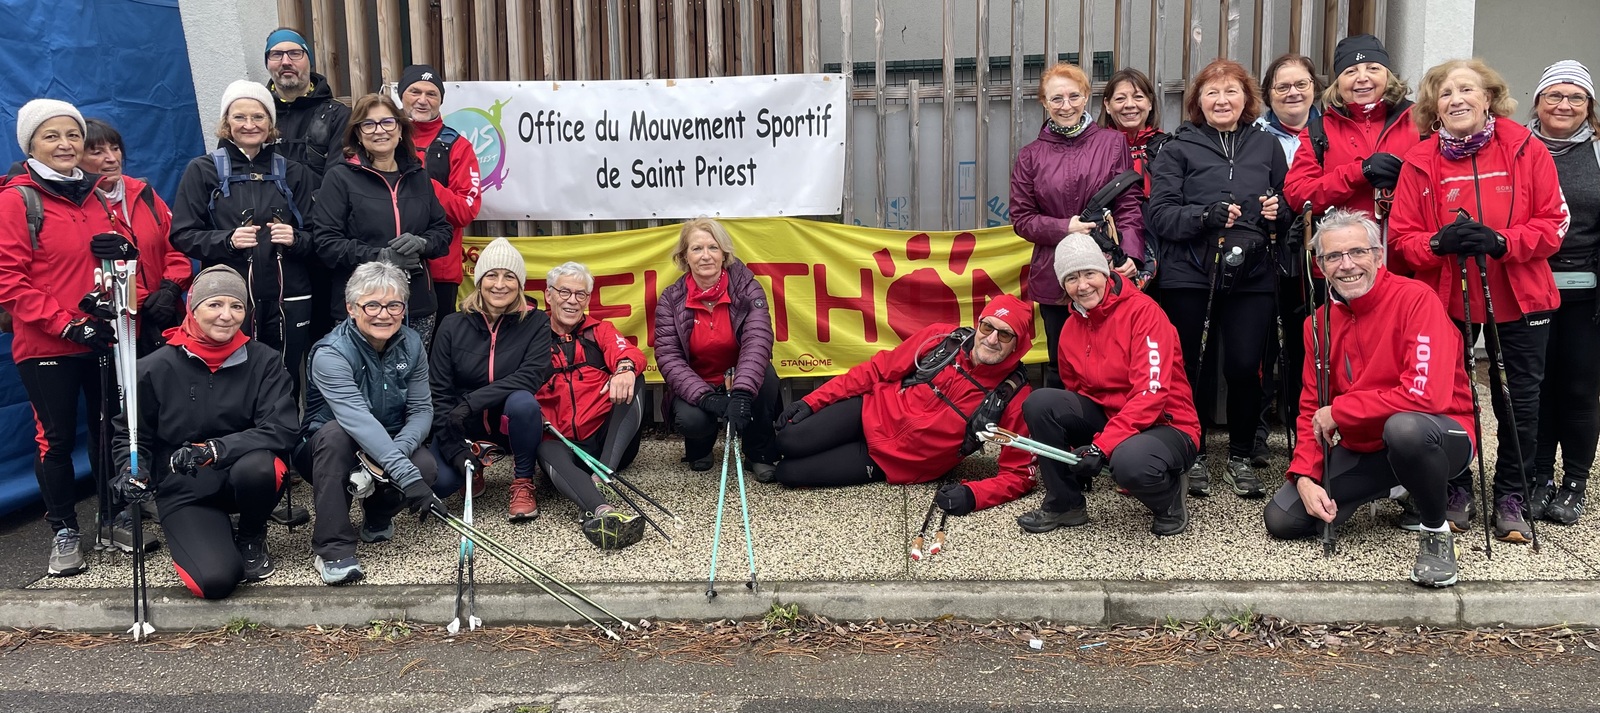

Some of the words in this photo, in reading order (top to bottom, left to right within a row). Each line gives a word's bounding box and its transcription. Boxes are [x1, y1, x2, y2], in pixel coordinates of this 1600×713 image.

[518, 110, 585, 144] Office
[595, 109, 619, 142] du
[629, 110, 746, 141] Mouvement
[756, 103, 832, 147] Sportif
[596, 157, 621, 188] de
[631, 158, 686, 188] Saint
[695, 155, 757, 187] Priest
[780, 358, 832, 367] STANHOME
[1408, 332, 1431, 396] JOCEL
